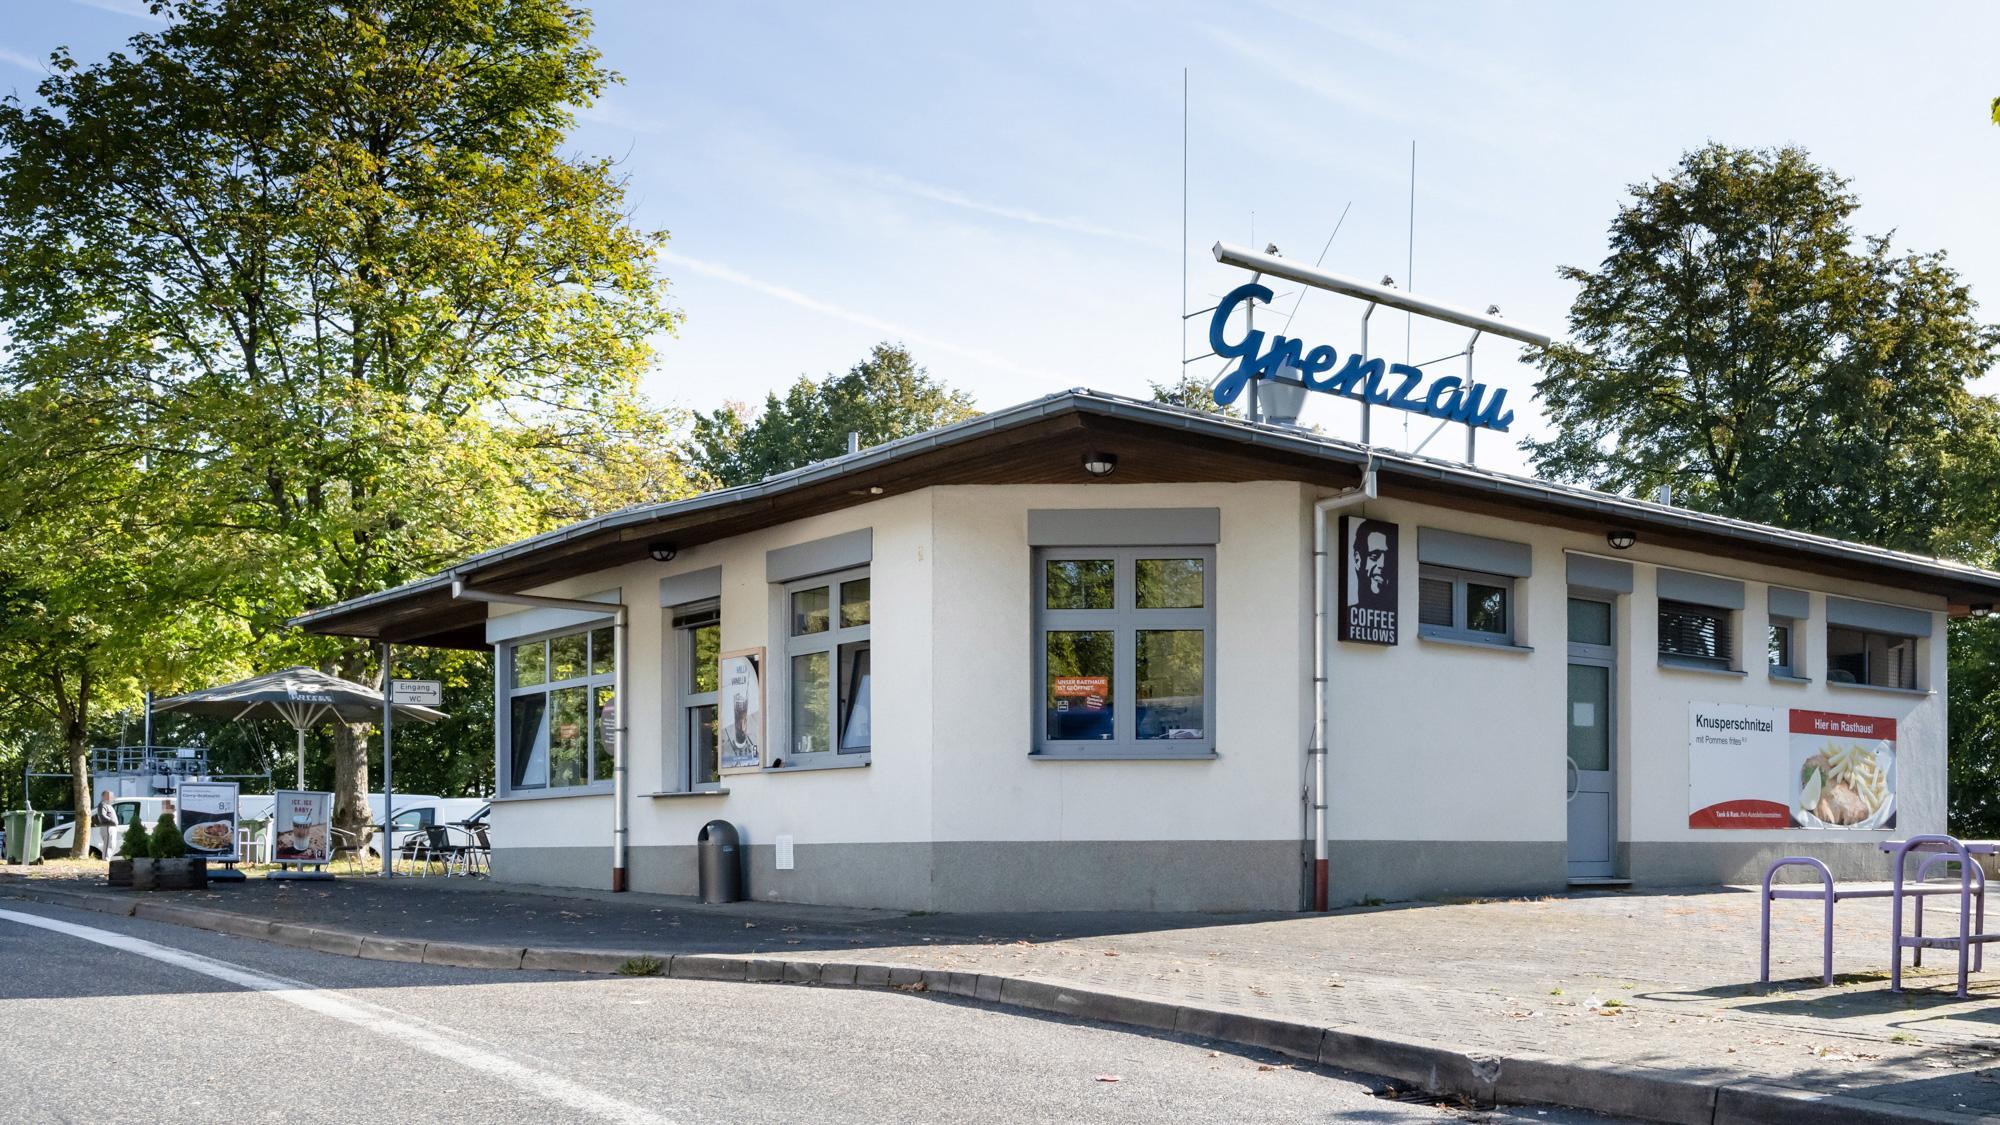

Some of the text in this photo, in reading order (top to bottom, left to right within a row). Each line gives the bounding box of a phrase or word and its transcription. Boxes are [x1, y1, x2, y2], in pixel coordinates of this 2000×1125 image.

[1209, 283, 1514, 431] Grenzau
[1350, 606, 1395, 630] COFFEE
[1350, 626, 1395, 643] FELLOWS
[400, 684, 431, 692] Eingang
[1696, 714, 1773, 732] Knusperschnitzel
[1814, 719, 1874, 734] Hier im Rasthaus!
[1696, 736, 1704, 744] mit
[1705, 735, 1728, 745] Pommes
